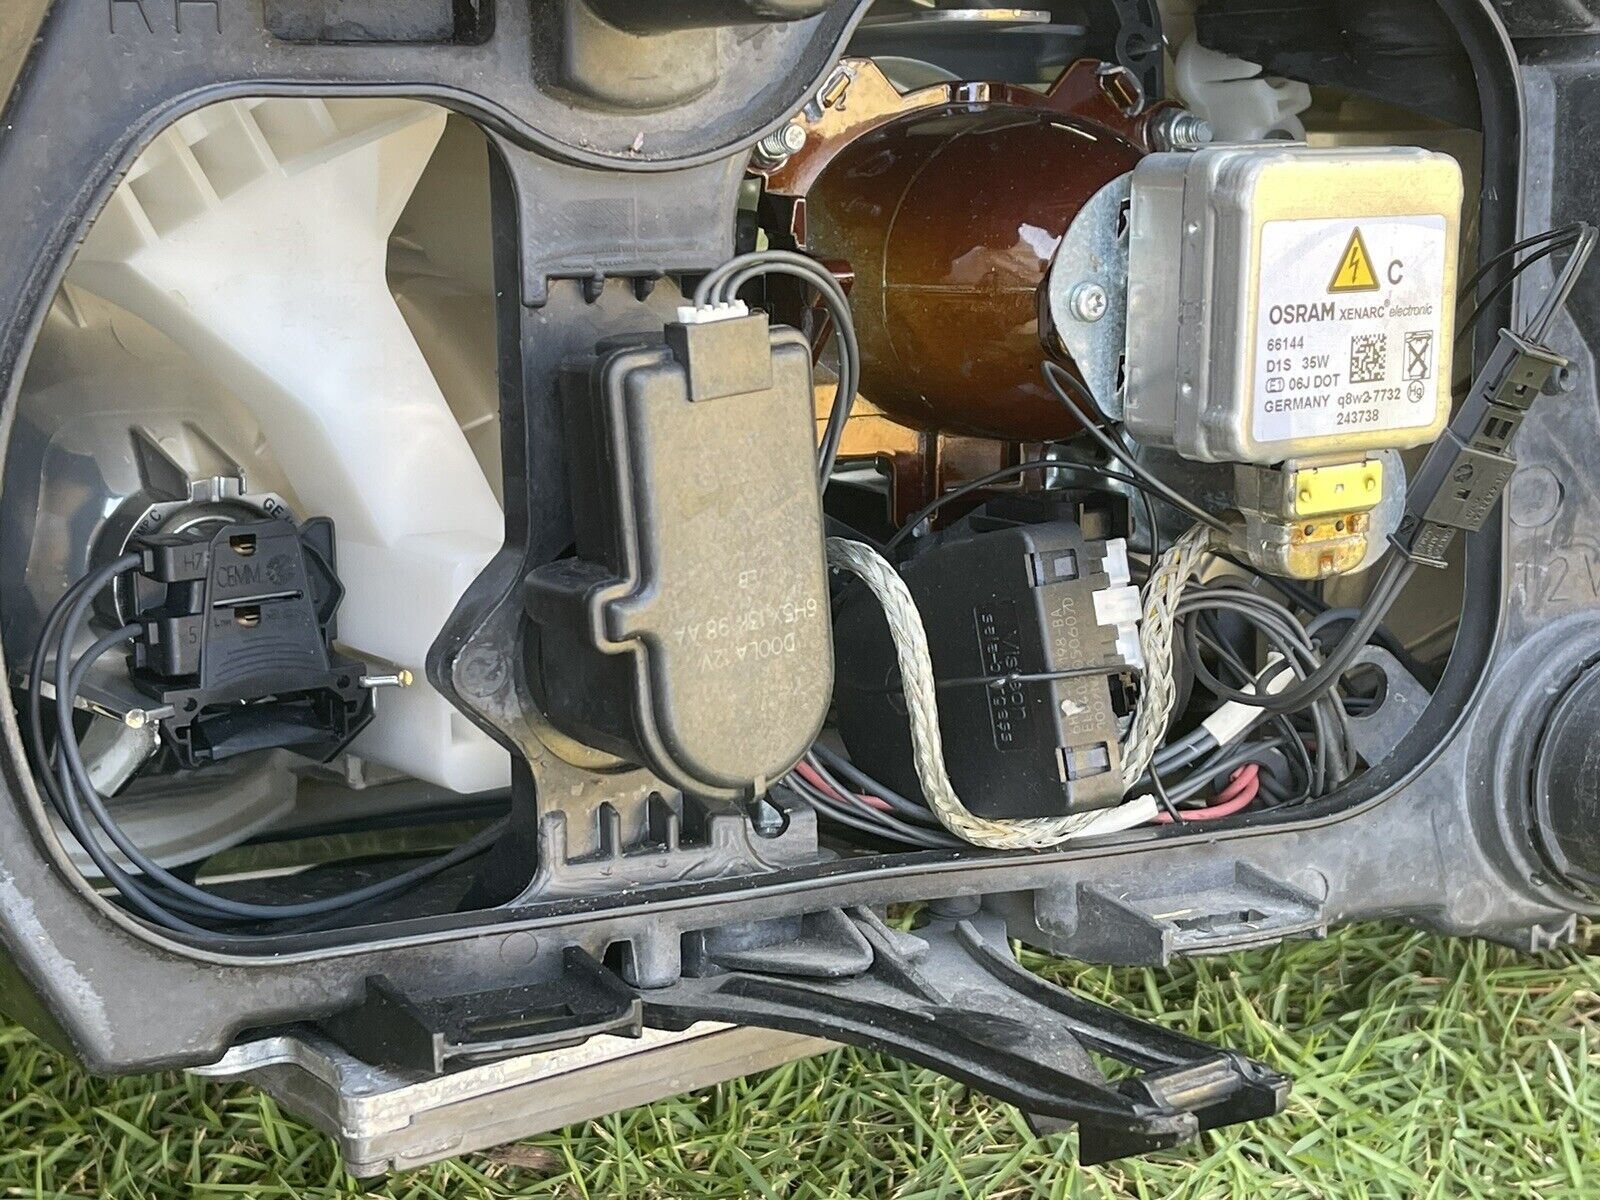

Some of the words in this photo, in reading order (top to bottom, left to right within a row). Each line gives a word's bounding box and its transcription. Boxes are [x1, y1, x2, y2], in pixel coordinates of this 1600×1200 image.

[1387, 259, 1403, 285] C
[1269, 302, 1335, 325] OSRAM
[1389, 303, 1433, 318] electronic
[1267, 336, 1304, 351] 66144
[1266, 358, 1292, 373] D1S
[1302, 355, 1330, 370] 35W
[1289, 376, 1310, 390] 06J
[1314, 373, 1340, 389] DOT
[1264, 394, 1330, 413] GERMANY
[1337, 409, 1379, 426] 243738
